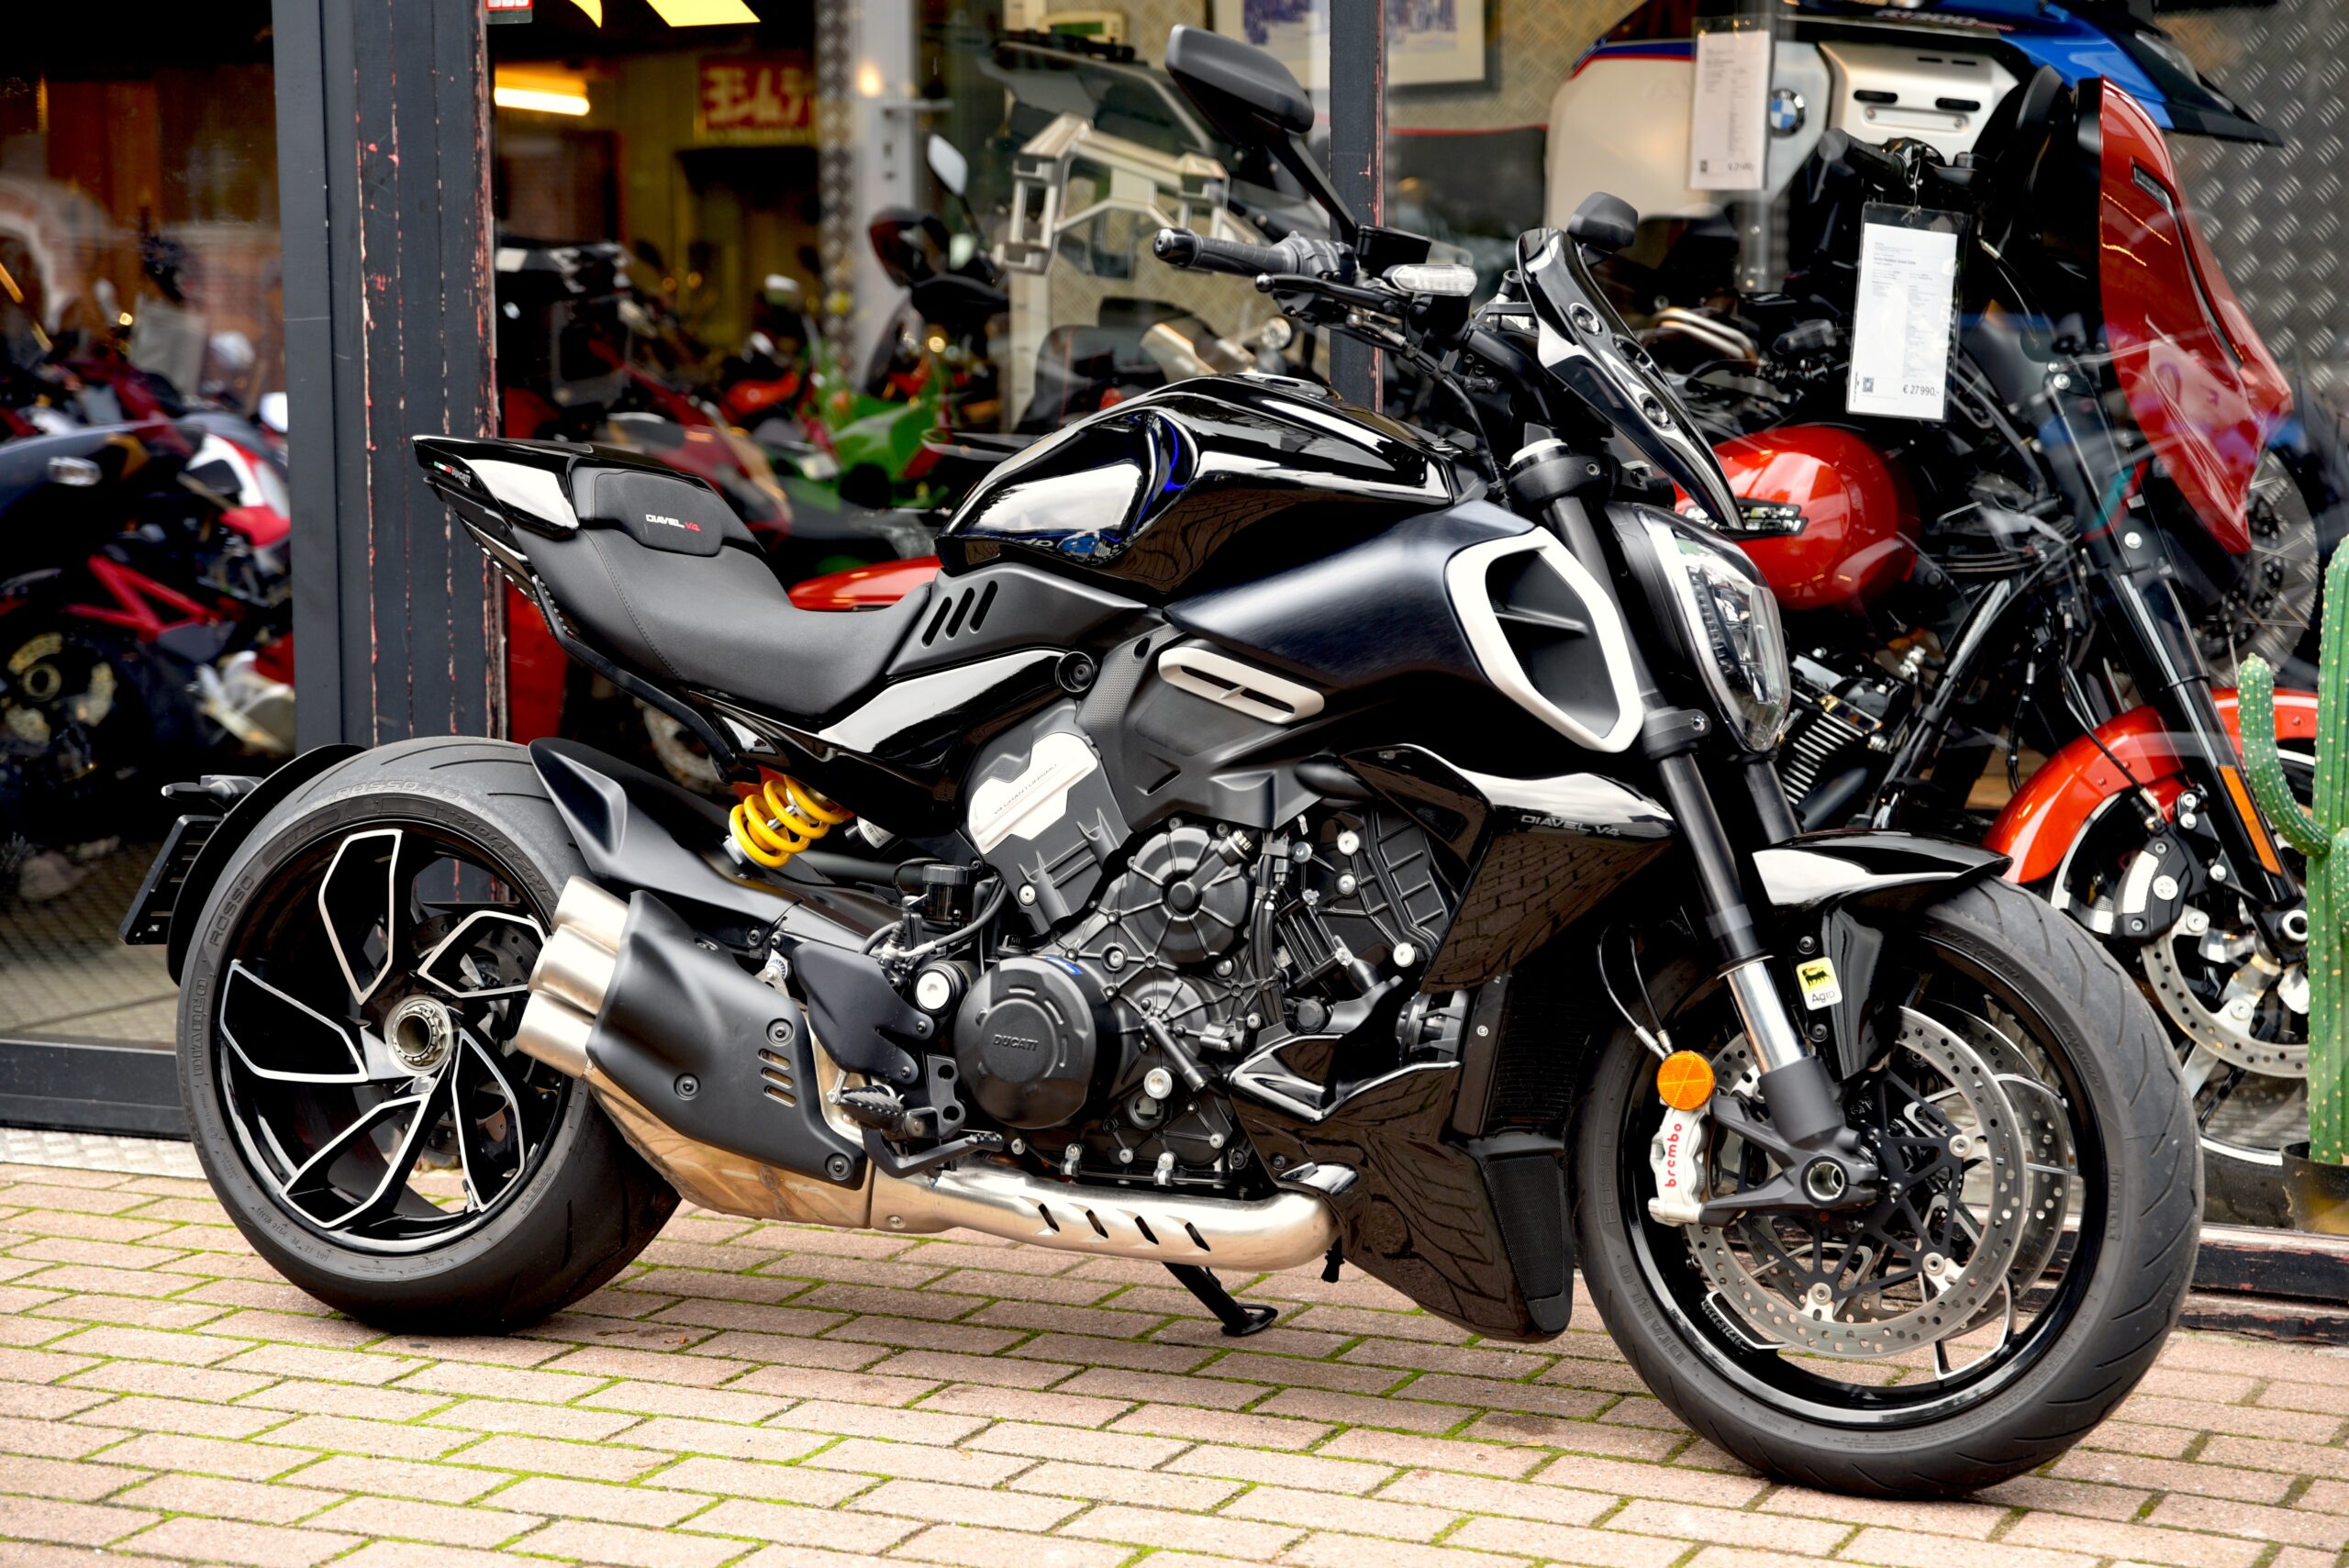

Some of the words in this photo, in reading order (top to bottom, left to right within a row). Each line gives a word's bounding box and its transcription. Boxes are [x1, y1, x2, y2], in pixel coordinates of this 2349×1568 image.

[451, 467, 472, 483] DUCATI
[645, 514, 685, 528] DIAVEL
[684, 520, 701, 532] V4
[1520, 814, 1592, 832] DIAVEL
[1595, 825, 1620, 837] V4
[191, 977, 207, 1077] DIABLO
[208, 874, 255, 947] ROSSO
[1811, 990, 1836, 1004] Agip
[993, 1033, 1039, 1051] DUCATI
[1664, 1122, 1683, 1188] brembo
[1599, 1129, 1617, 1226] ROSSO
[1620, 1264, 1687, 1365] DIABLO
